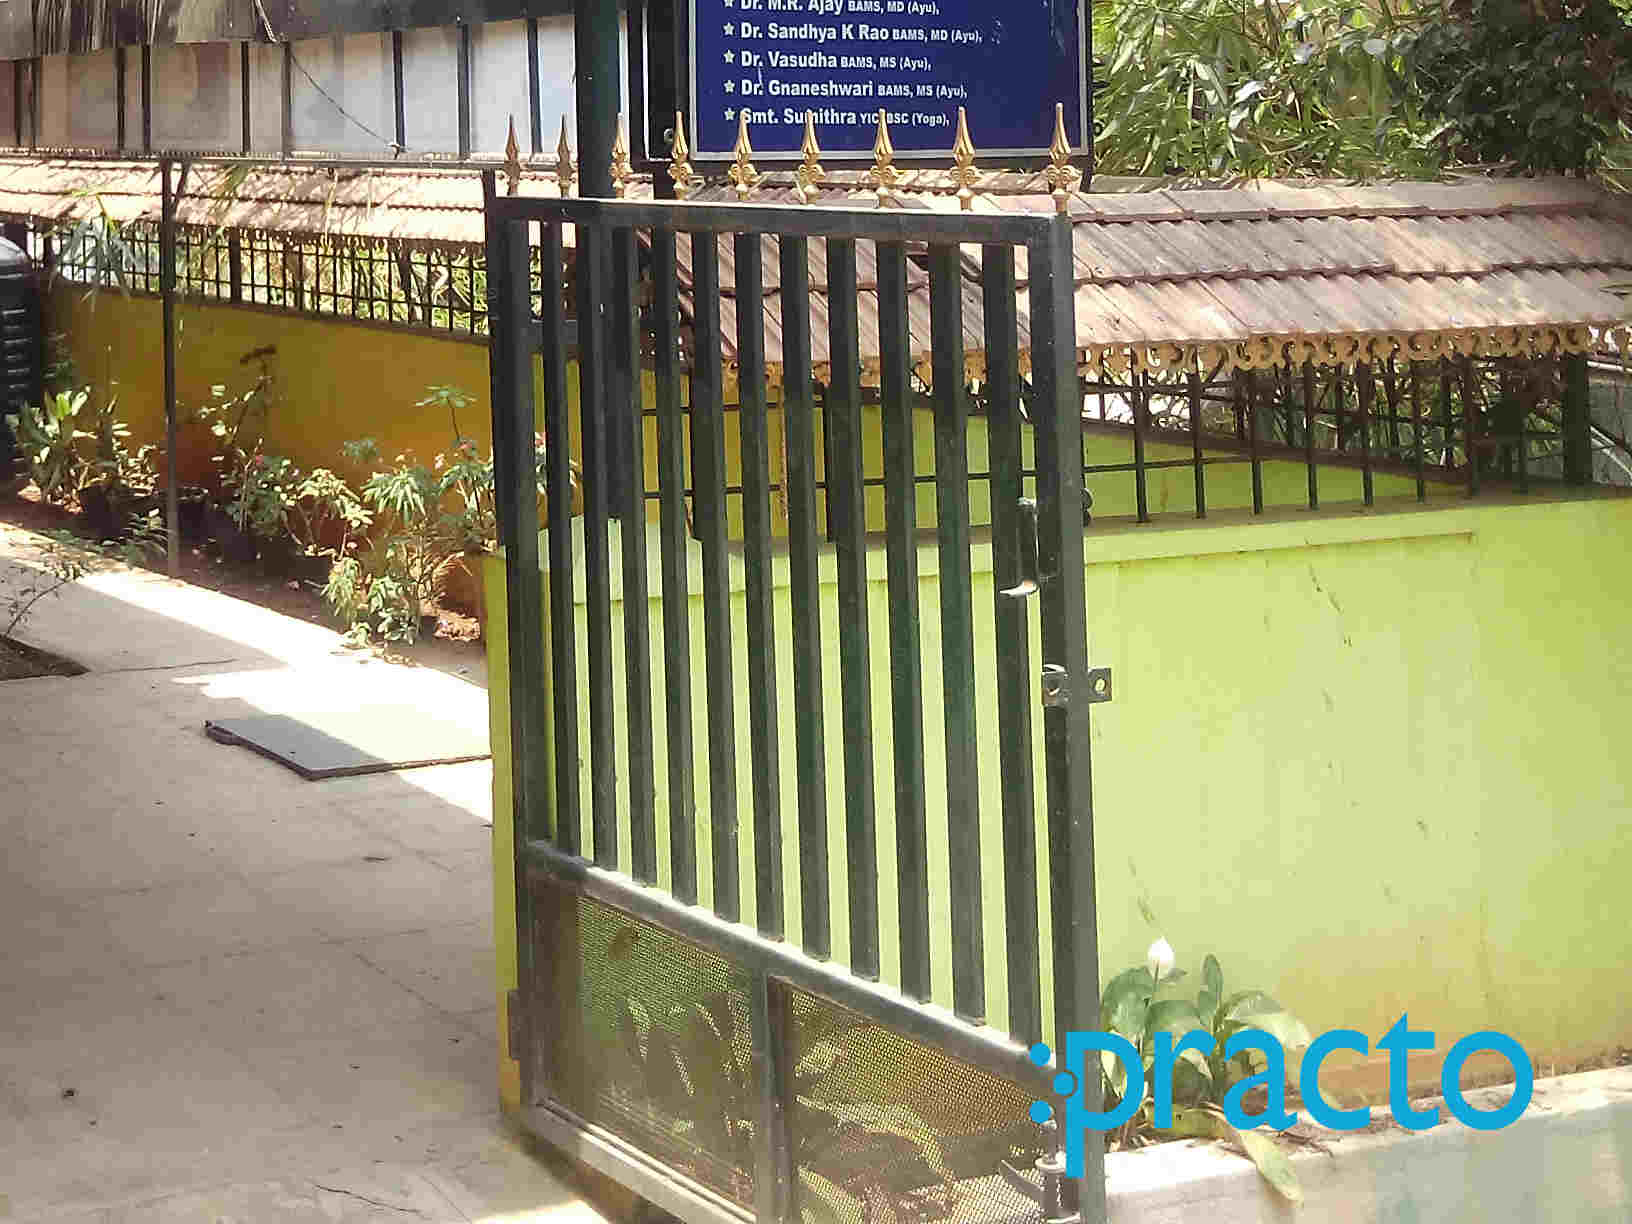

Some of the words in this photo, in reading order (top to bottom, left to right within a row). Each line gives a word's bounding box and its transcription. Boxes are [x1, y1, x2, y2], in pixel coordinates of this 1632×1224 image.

[847, 0, 884, 14] BAMS,
[887, 1, 905, 13] MD
[907, 1, 940, 15] (Ayu),
[741, 22, 763, 39] Dr.
[768, 22, 837, 43] Sandhya
[841, 24, 854, 40] K
[858, 24, 889, 40] Rao
[892, 29, 928, 42] BAMS,
[930, 29, 948, 41] MD
[951, 30, 983, 43] (Ayu),
[741, 50, 764, 67] Dr.
[768, 51, 838, 68] Vasudha
[840, 56, 877, 70] BAMS,
[879, 57, 897, 68] MS
[899, 57, 932, 71] (Ayu),
[741, 79, 764, 96] Dr.
[768, 80, 874, 96] Gnaneshwari
[877, 85, 914, 98] BAMS,
[916, 85, 933, 97] MS
[935, 85, 968, 99] (Ayu),
[741, 107, 779, 124] Smt.
[911, 112, 950, 127] (Yoga),
